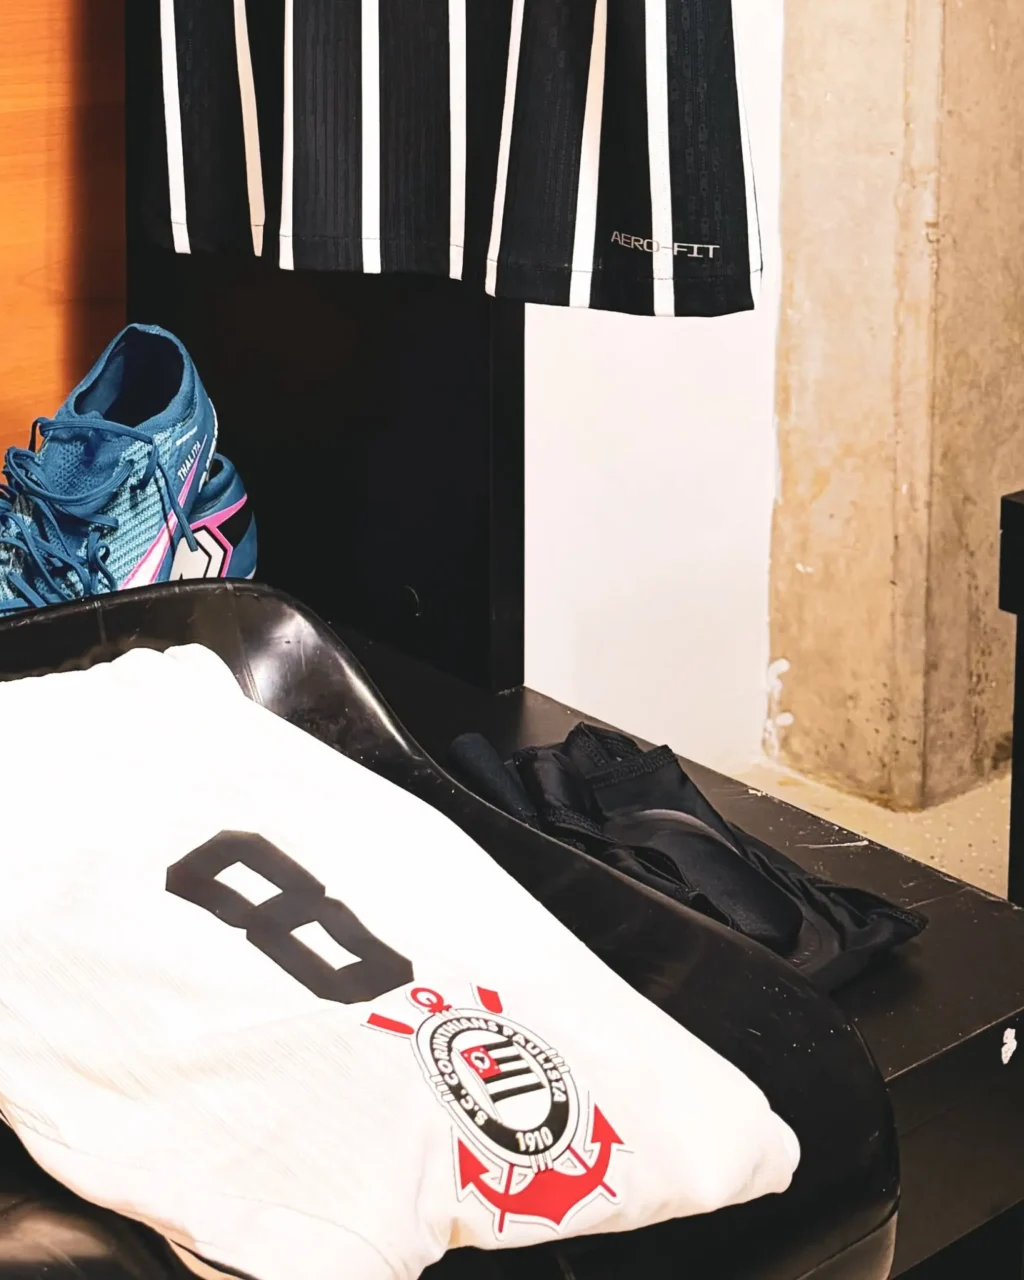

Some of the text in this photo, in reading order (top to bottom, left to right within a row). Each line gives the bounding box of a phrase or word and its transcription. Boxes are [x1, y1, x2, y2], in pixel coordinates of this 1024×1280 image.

[177, 440, 202, 482] THALITA
[164, 828, 416, 1005] 8
[432, 1017, 500, 1086] CORINTHIANS
[501, 1024, 568, 1103] PAULISTA
[515, 1125, 554, 1152] 1910
